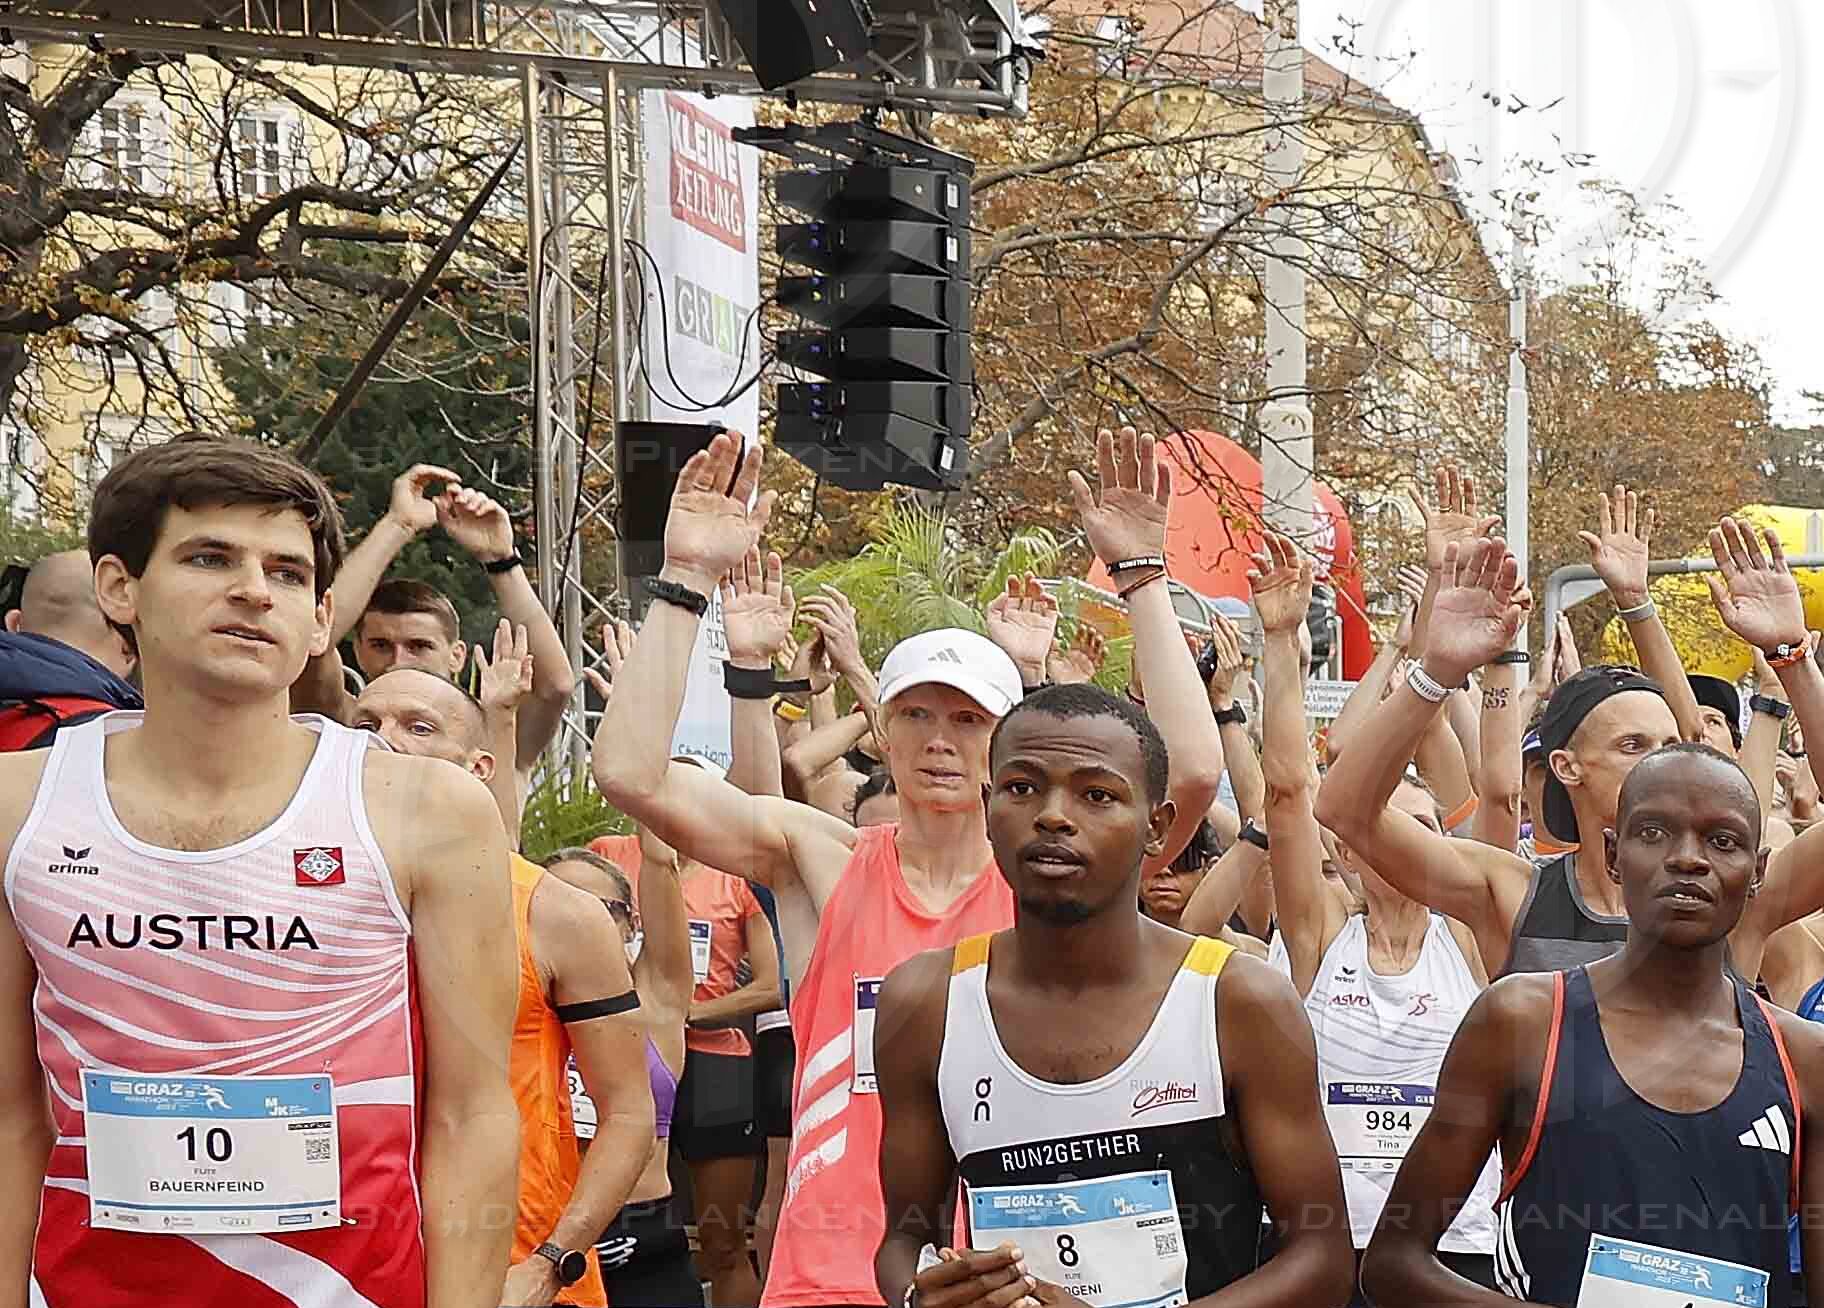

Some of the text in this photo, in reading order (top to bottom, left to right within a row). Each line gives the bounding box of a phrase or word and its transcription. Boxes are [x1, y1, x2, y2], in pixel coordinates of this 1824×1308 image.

[670, 108, 739, 185] KLEINE
[675, 158, 743, 237] ZEITUNG
[67, 913, 320, 951] AUSTRIA
[134, 1082, 183, 1096] GRAZ
[1366, 1110, 1412, 1131] 984
[176, 1126, 233, 1162] 10
[1001, 1133, 1141, 1173] RUN2GETHER
[1377, 1139, 1400, 1149] Tina
[149, 1180, 265, 1193] BAUERNFEIND
[1012, 1194, 1045, 1206] GRAZ
[1056, 1233, 1079, 1267] 8
[1641, 1253, 1681, 1271] GRAZ
